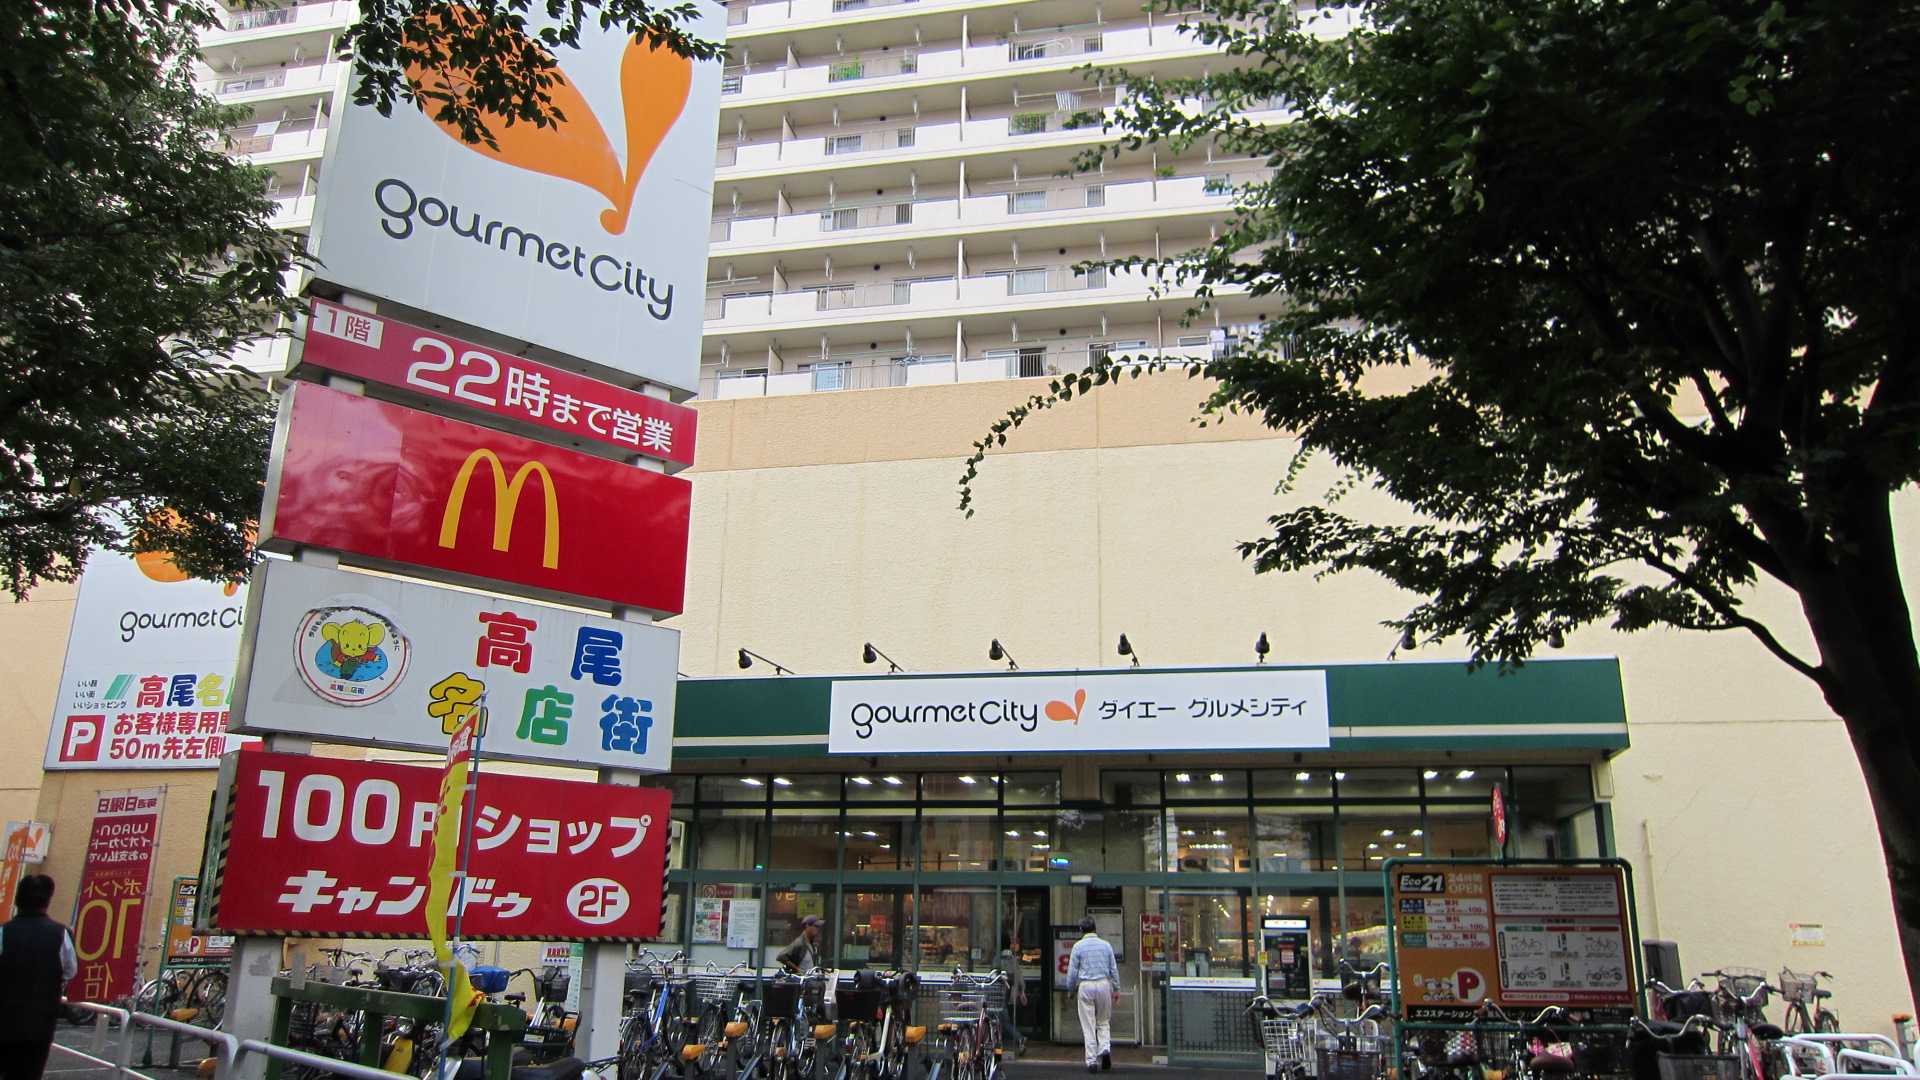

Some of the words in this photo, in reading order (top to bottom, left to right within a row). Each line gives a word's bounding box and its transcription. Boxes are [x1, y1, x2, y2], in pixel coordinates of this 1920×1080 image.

[327, 308, 371, 343] 1階
[406, 337, 674, 453] 22時まで営業
[119, 606, 243, 642] gourmetCi
[73, 700, 127, 709] いいショッピング
[136, 672, 235, 709] 高尾名
[851, 699, 1038, 739] gourmetCity
[1098, 699, 1176, 719] ダイエー
[1188, 697, 1307, 719] グルメシティ
[66, 721, 98, 757] P
[277, 870, 532, 918] キャンドゥ
[578, 884, 620, 917] 2F
[1420, 875, 1443, 891] 21
[1448, 883, 1483, 894] OPEN
[1457, 970, 1480, 1000] P
